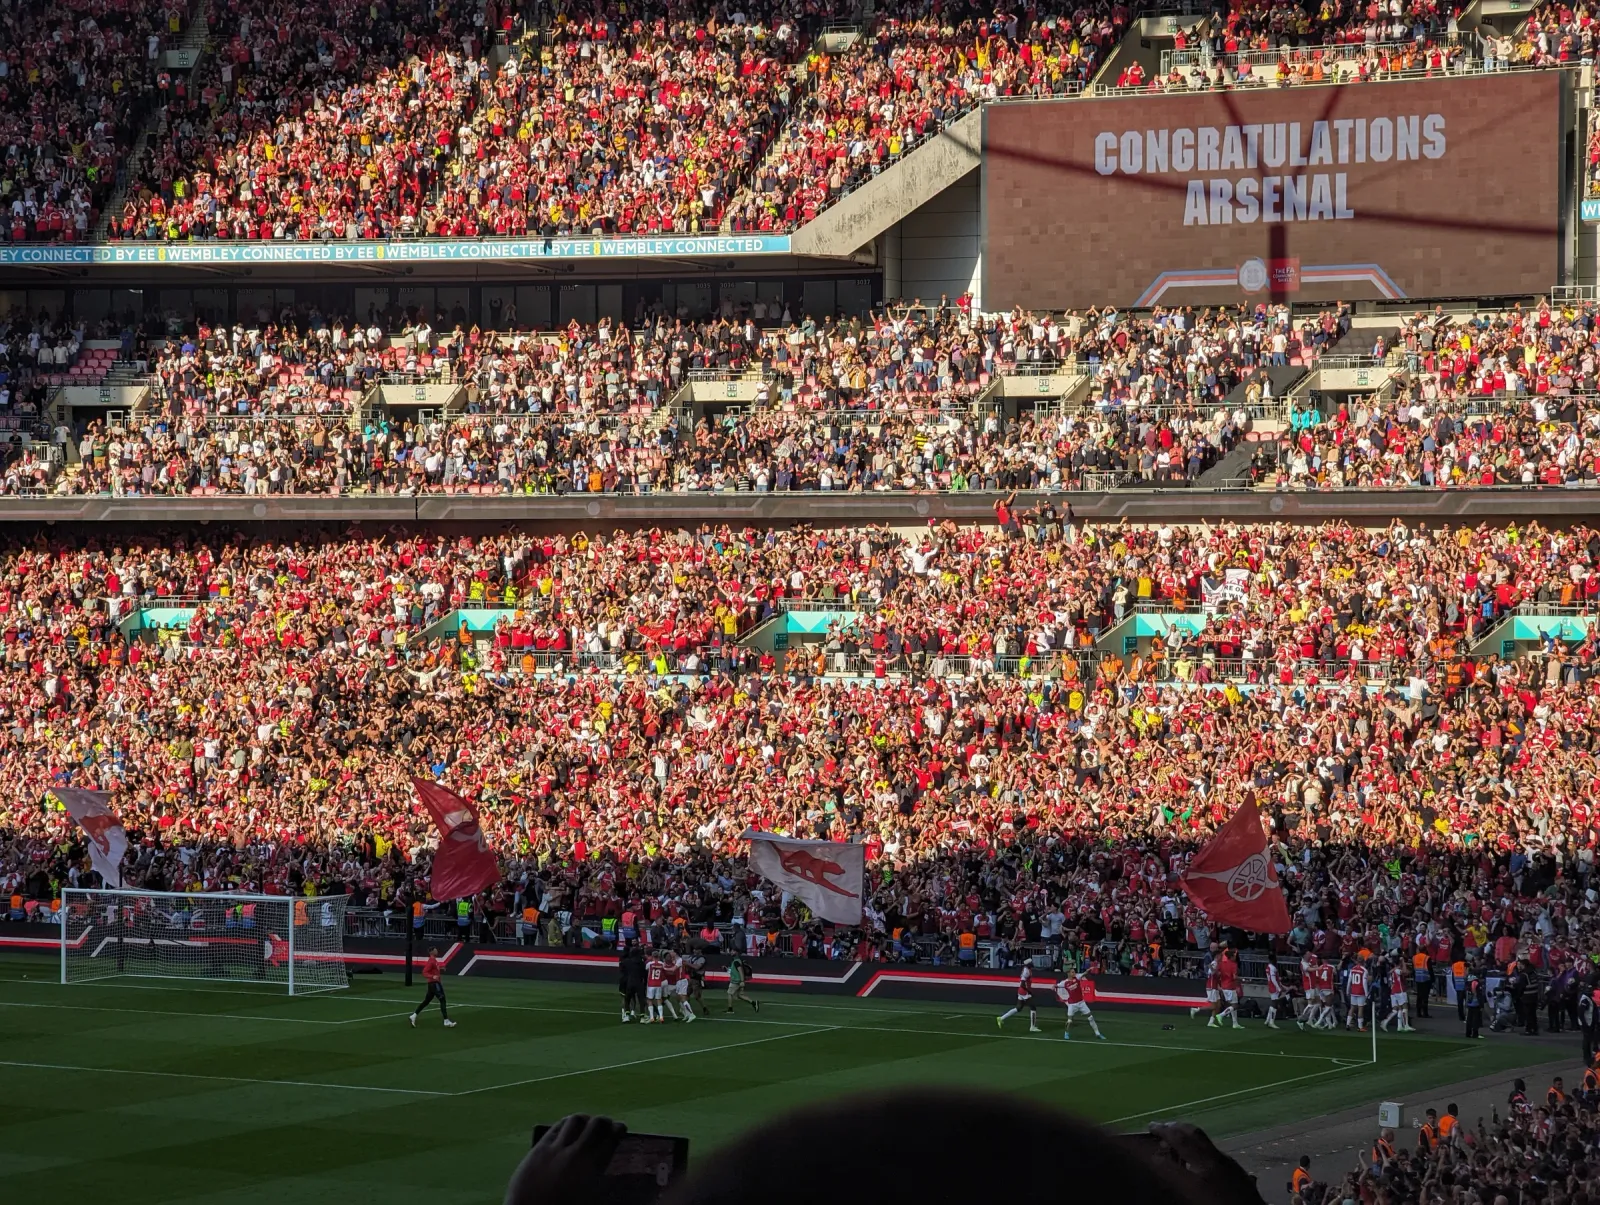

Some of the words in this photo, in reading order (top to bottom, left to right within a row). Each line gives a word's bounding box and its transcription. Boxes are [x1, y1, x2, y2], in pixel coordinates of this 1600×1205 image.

[1094, 113, 1447, 176] CONGRATULATIONS
[1182, 172, 1355, 226] ARSENAL
[22, 250, 111, 261] CONNECTED
[116, 250, 135, 261] BY
[138, 249, 156, 260] EE
[168, 248, 242, 260] WEMBLEY
[242, 247, 331, 260] CONNECTED
[334, 247, 354, 258] BY
[358, 246, 374, 258] EE
[386, 245, 458, 258] WEMBLEY
[460, 244, 544, 257] CONNECTED
[552, 243, 570, 256] BY
[574, 243, 590, 255] EE
[602, 242, 675, 254] WEMBLEY
[676, 240, 764, 252] CONNECTED
[651, 969, 660, 980] 19
[1321, 970, 1328, 981] 4
[1351, 973, 1361, 985] 10
